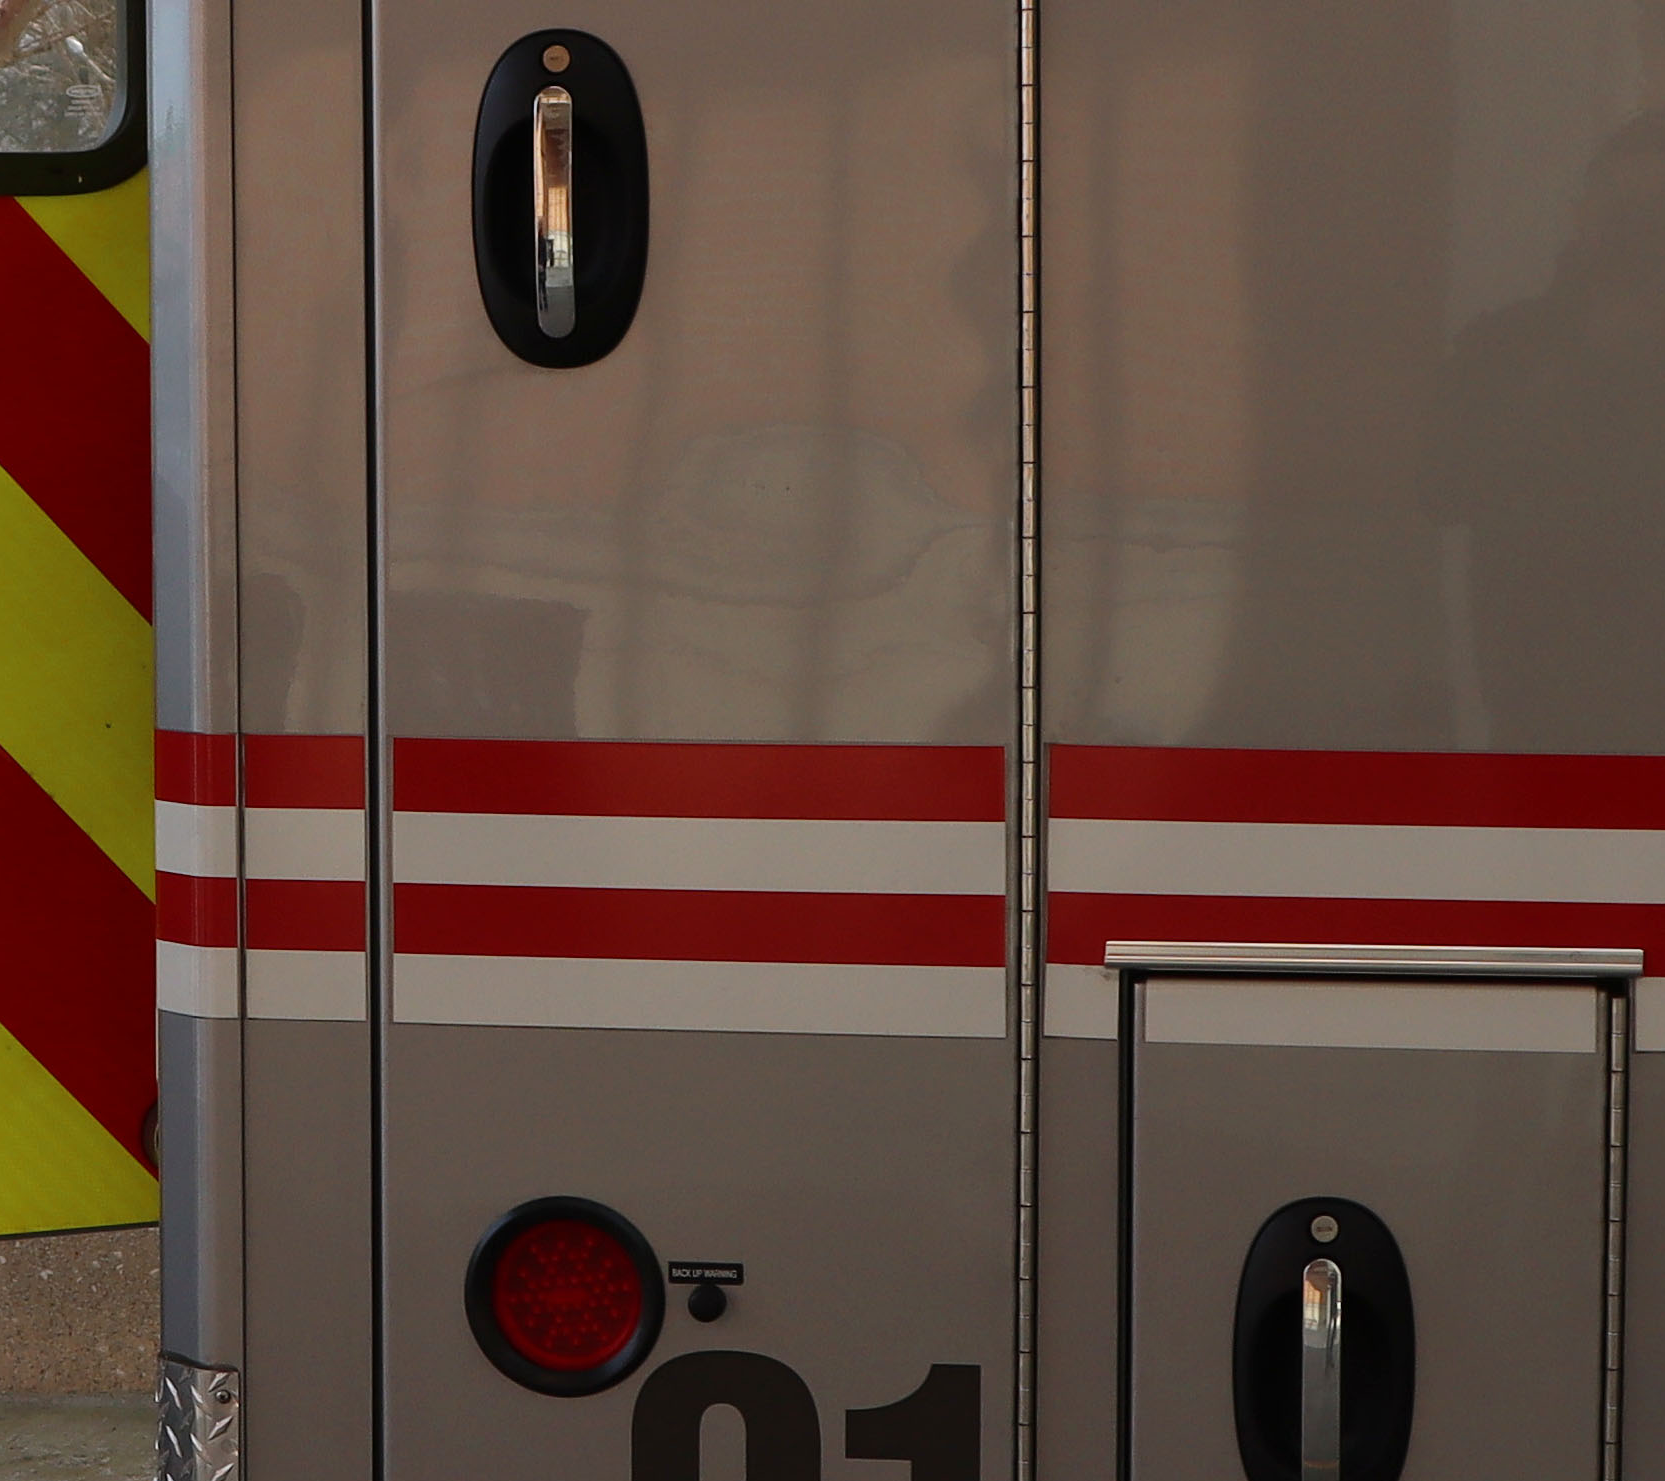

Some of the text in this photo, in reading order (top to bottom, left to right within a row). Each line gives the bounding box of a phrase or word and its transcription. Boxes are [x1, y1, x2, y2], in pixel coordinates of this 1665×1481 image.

[672, 1268, 738, 1279] BACK UP WARNING
